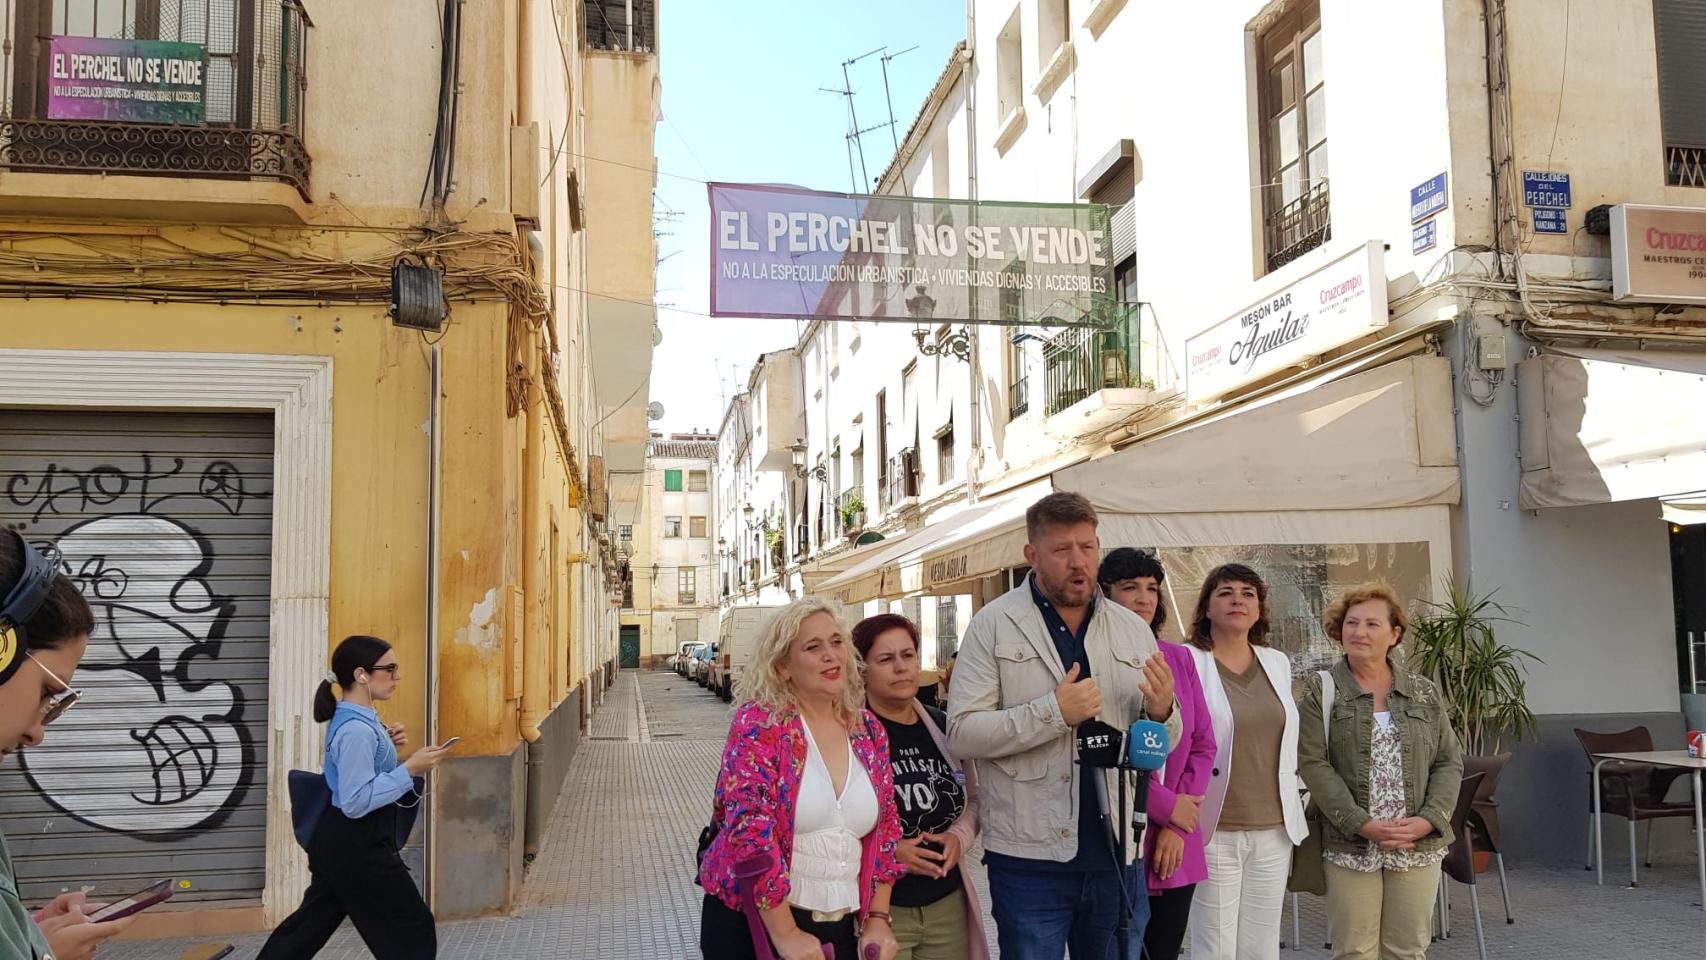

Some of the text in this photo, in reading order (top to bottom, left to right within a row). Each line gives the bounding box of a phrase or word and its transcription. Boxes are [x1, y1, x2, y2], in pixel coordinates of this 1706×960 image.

[54, 54, 202, 85] EL PERCHEL NO SE VENDE
[1418, 180, 1436, 197] CALLE
[1526, 191, 1570, 206] PERCHEL
[720, 210, 1106, 266] EL PERCHEL NO SE VENDE
[1643, 255, 1692, 265] MAESTROS
[723, 261, 740, 279] NO
[741, 262, 750, 279] A
[752, 263, 768, 280] LA
[770, 261, 855, 283] ESPECULACIÓN
[938, 267, 994, 288] VIVIENDAS
[995, 271, 1033, 290] DIGNAS
[1034, 274, 1042, 290] Y
[1045, 274, 1106, 294] ACCESIBLES
[1319, 274, 1362, 305] Cruzcampo
[1273, 293, 1292, 313] BAR
[1229, 310, 1310, 375] Aguilar
[899, 747, 920, 756] PARA
[894, 783, 935, 811] YO
